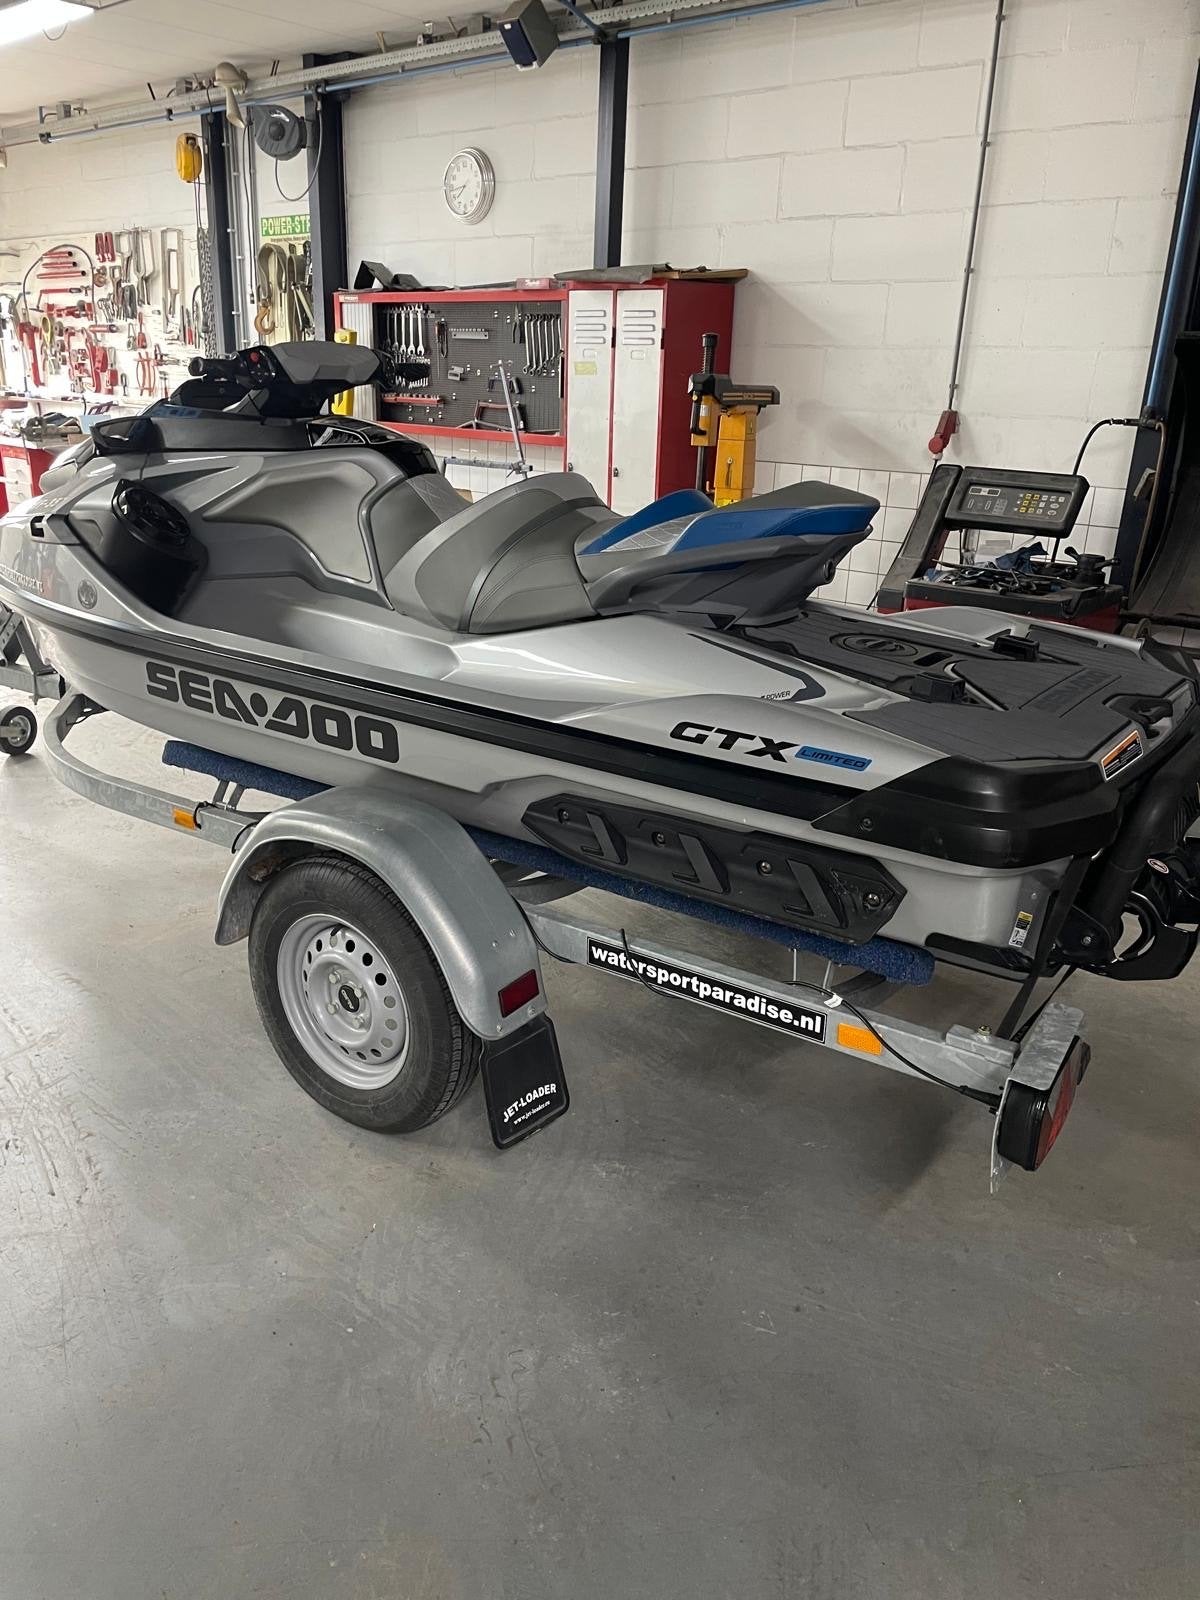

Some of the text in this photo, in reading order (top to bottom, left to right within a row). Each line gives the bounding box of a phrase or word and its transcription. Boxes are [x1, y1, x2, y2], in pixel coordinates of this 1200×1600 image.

[670, 722, 867, 769] GTX LIMITED
[591, 945, 822, 1034] watersportparadise.nl
[503, 1083, 557, 1123] JET-LOADER
